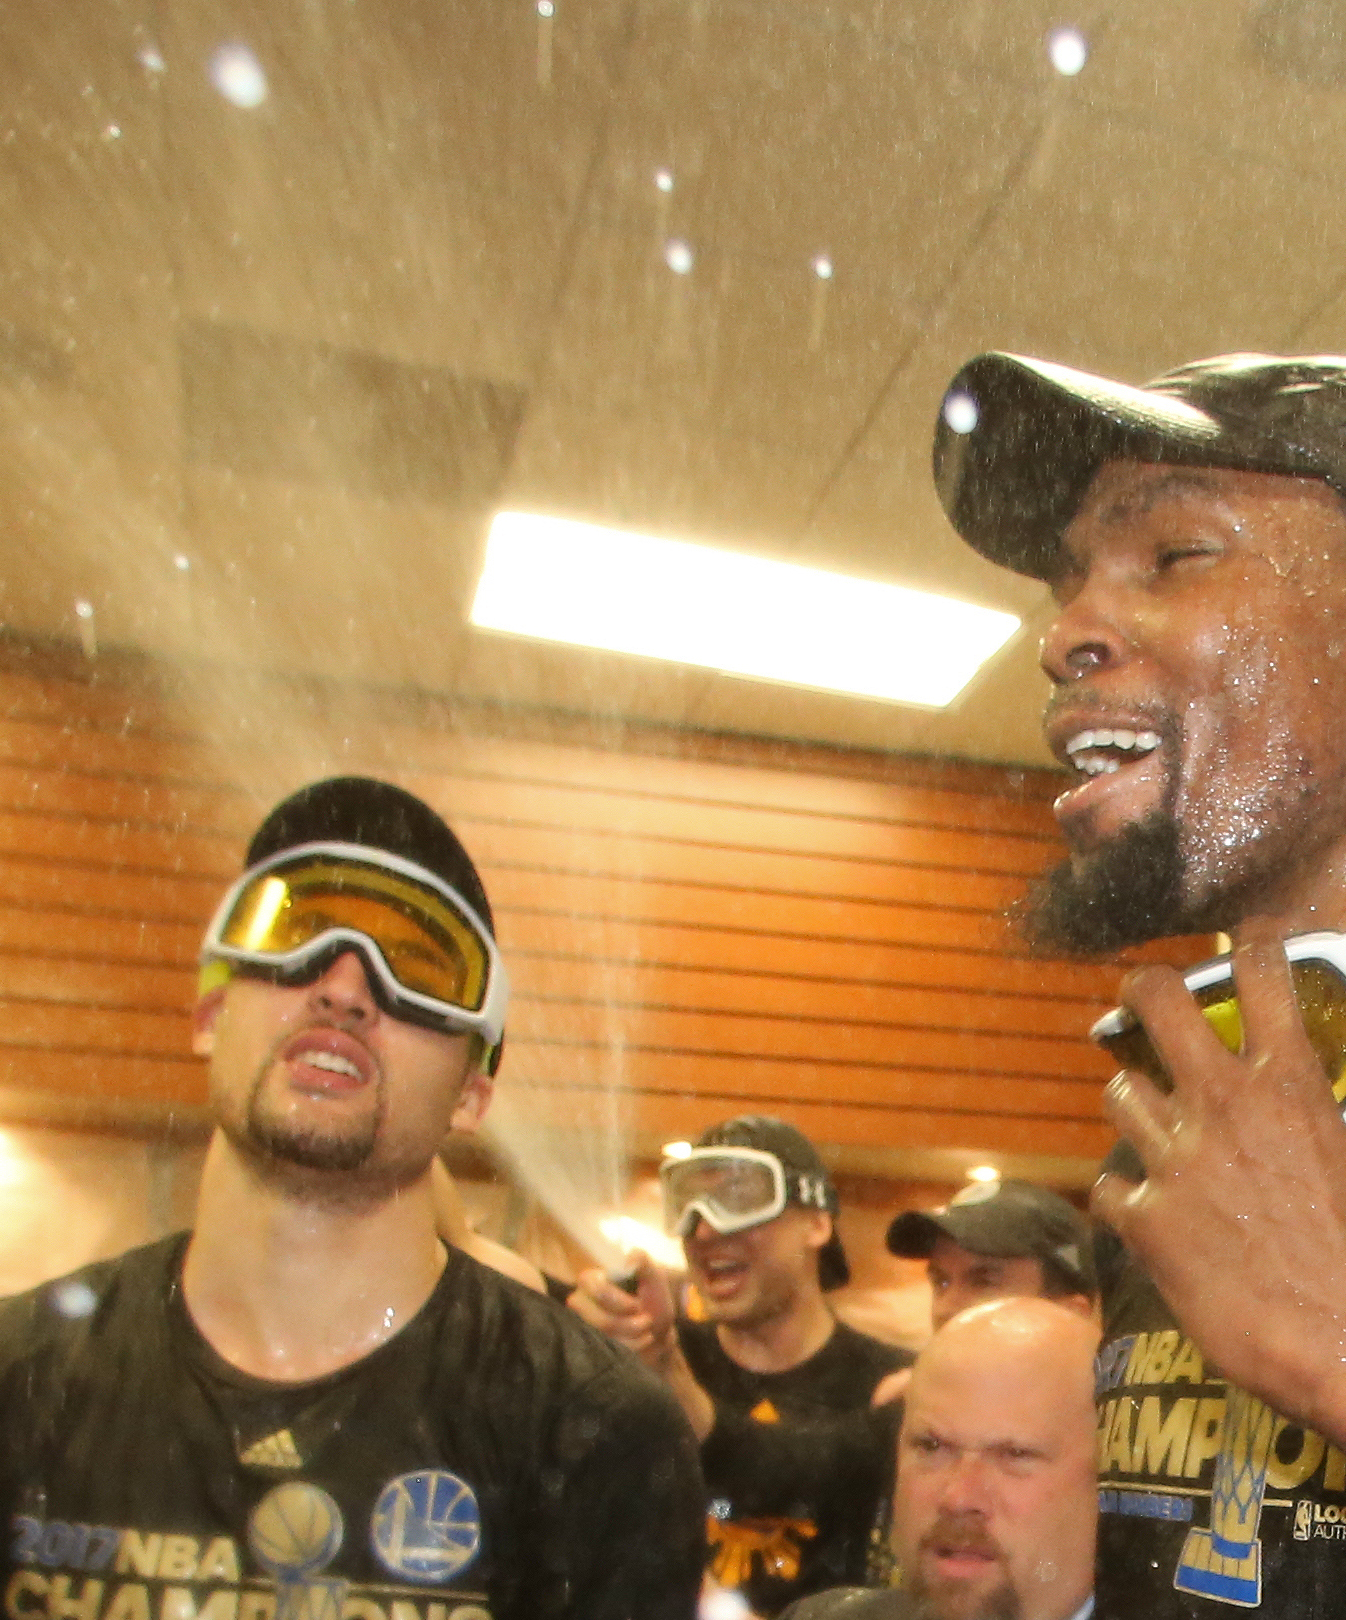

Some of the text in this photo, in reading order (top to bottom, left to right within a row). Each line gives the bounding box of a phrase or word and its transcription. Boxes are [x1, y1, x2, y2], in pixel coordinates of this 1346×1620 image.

[1124, 1330, 1203, 1386] NBA
[13, 1515, 241, 1583] 2017 NBA
